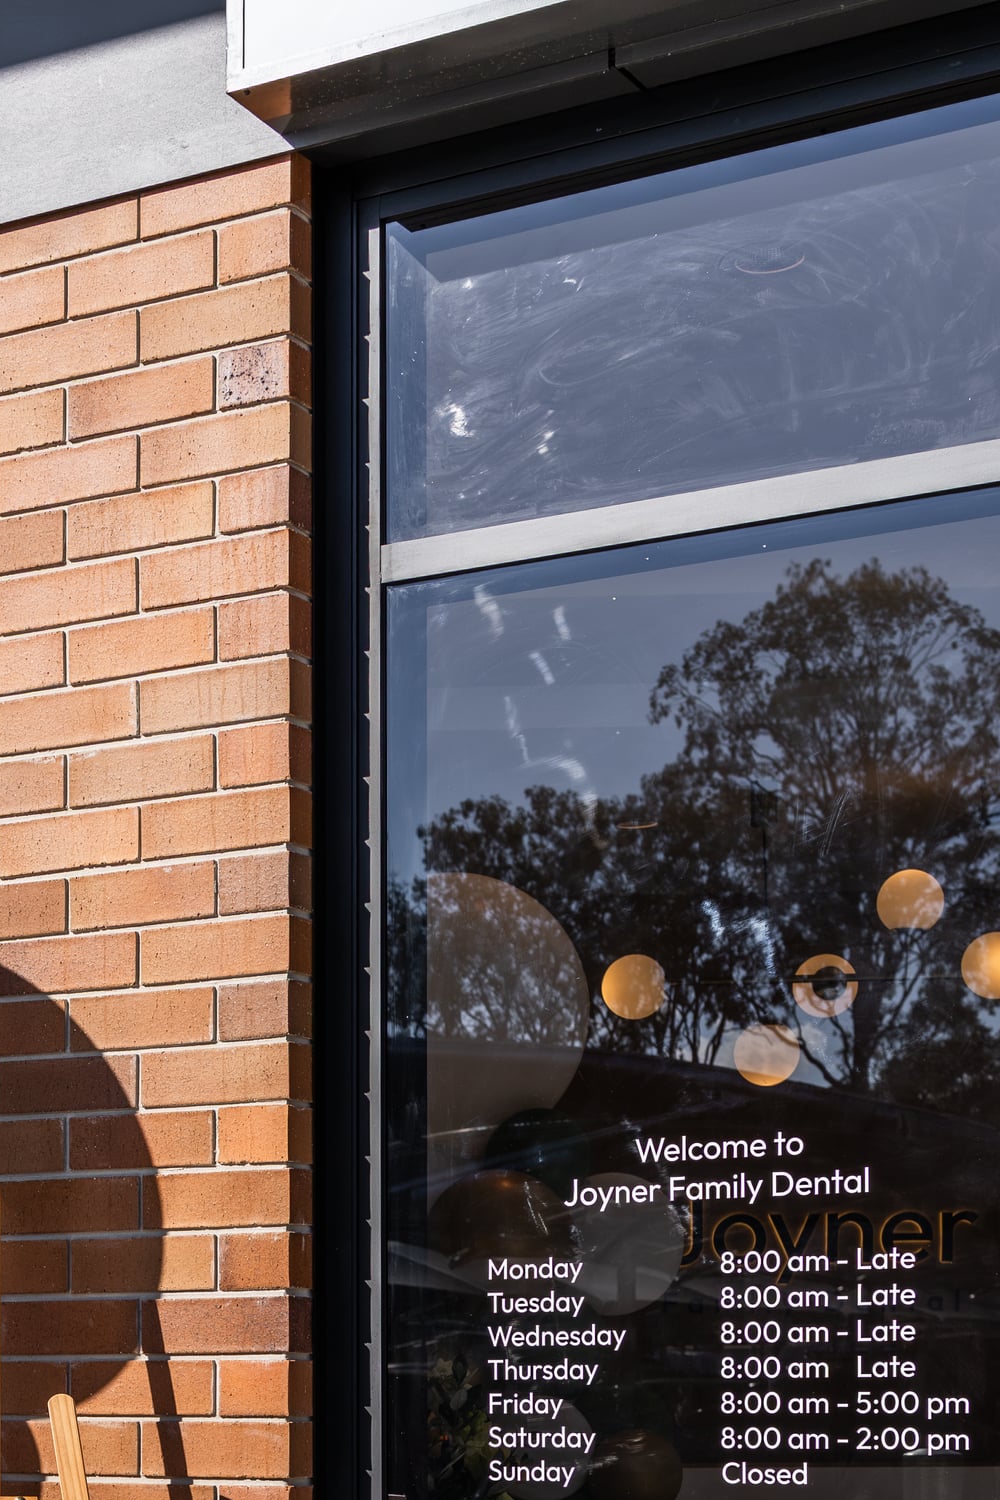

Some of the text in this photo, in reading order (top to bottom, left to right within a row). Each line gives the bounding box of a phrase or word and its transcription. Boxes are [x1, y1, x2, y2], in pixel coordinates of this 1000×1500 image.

[635, 1131, 804, 1163] Welcome to
[563, 1166, 870, 1213] Joyner Family Dental
[488, 1256, 584, 1284] Monday
[720, 1249, 781, 1274] 8:00
[787, 1255, 829, 1272] am
[857, 1246, 916, 1270] Late
[487, 1290, 585, 1318] Tuesday
[720, 1285, 781, 1309] 8:00
[787, 1290, 829, 1308] am
[857, 1283, 916, 1306] Late
[487, 1323, 627, 1352] Wednesday
[720, 1320, 781, 1344] 8:00
[787, 1326, 829, 1343] am
[857, 1319, 916, 1342] Late
[487, 1355, 916, 1386] Thursday 8:00 am Late
[489, 1392, 564, 1420] Friday
[720, 1391, 781, 1414] 8:00
[787, 1397, 829, 1414] am
[856, 1390, 920, 1414] 5:00
[927, 1397, 970, 1420] pm
[488, 1425, 596, 1454] Saturday
[720, 1426, 781, 1450] 8:00
[788, 1433, 829, 1450] am
[856, 1427, 922, 1450] 2:00
[927, 1433, 970, 1456] pm
[488, 1459, 808, 1488] Sunday Closed
